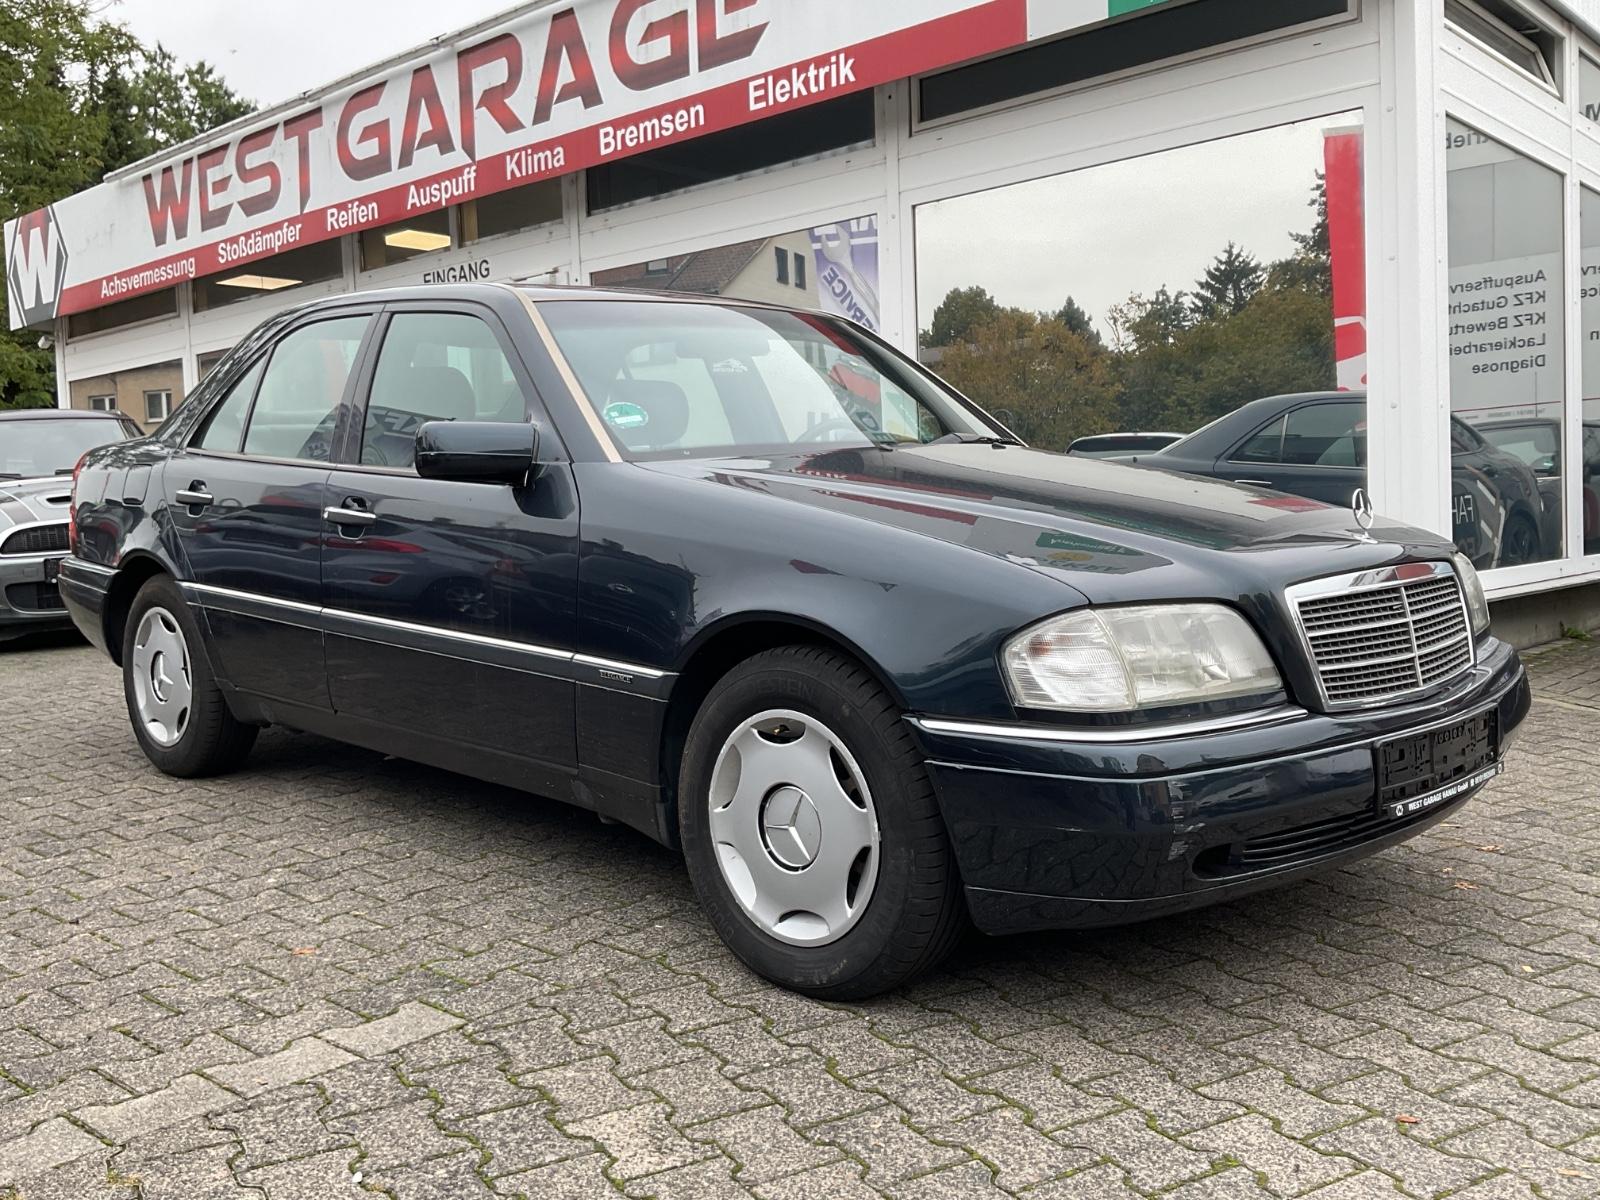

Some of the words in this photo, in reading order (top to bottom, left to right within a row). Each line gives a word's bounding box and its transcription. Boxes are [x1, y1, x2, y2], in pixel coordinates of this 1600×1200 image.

[100, 256, 196, 299] Achsvermessung
[217, 221, 303, 264] Stoßdämpfer
[327, 200, 379, 232] Reifen
[406, 165, 477, 210] Auspuff
[505, 144, 566, 181] Klima
[599, 104, 705, 156] Bremsen
[748, 53, 857, 112] Elektrik
[142, 106, 323, 247] WEST
[337, 0, 770, 182] GARAGE
[423, 259, 490, 284] EINGANG
[1408, 799, 1423, 811] WEST
